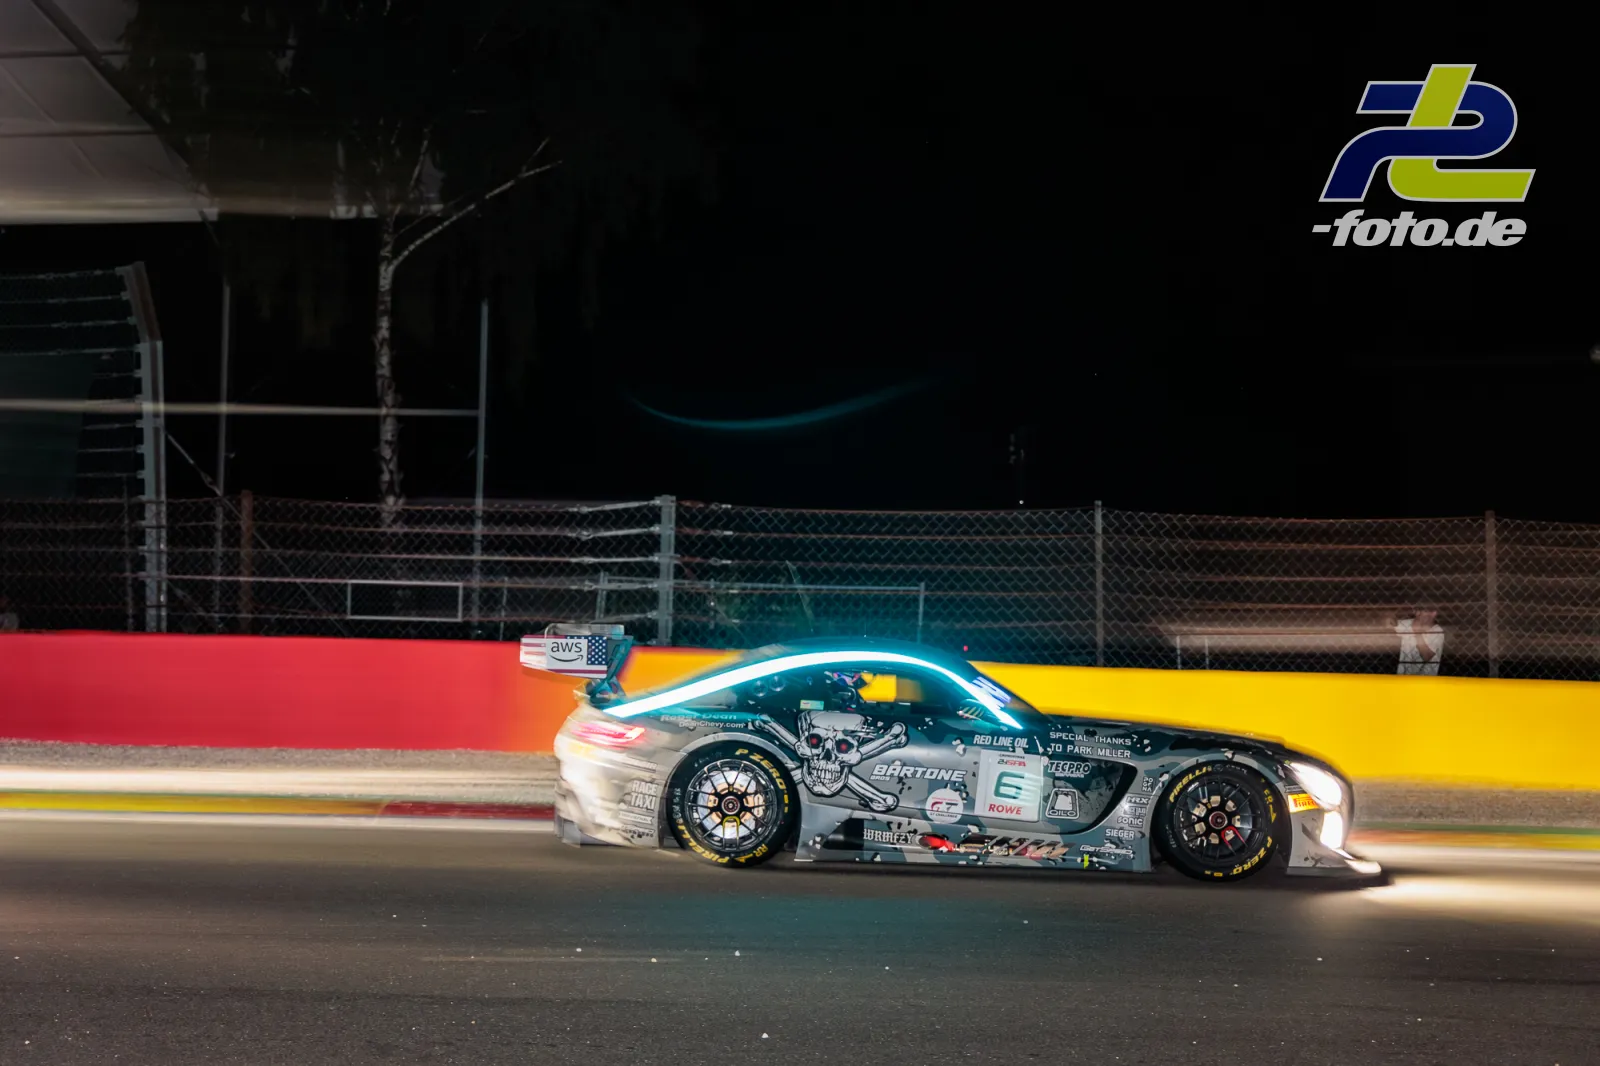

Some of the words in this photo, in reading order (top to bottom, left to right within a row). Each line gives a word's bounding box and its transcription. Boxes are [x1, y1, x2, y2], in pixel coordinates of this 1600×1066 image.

[551, 641, 582, 653] aws
[973, 734, 992, 746] RED
[993, 736, 1013, 747] LINE
[1014, 738, 1029, 748] OIL
[1050, 732, 1089, 742] SPECIAL
[1095, 736, 1132, 746] THANKS
[1050, 743, 1062, 752] TO
[1067, 744, 1092, 755] PARK
[1097, 748, 1131, 758] MILLER
[872, 764, 967, 781] BARTONE
[1048, 761, 1091, 774] TECPRO
[632, 779, 658, 795] RACE
[993, 771, 1025, 800] 6
[1169, 766, 1207, 803] PIRELLI
[630, 792, 657, 810] TAXI
[988, 803, 1023, 816] ROWE
[1105, 829, 1135, 840] SIEGER
